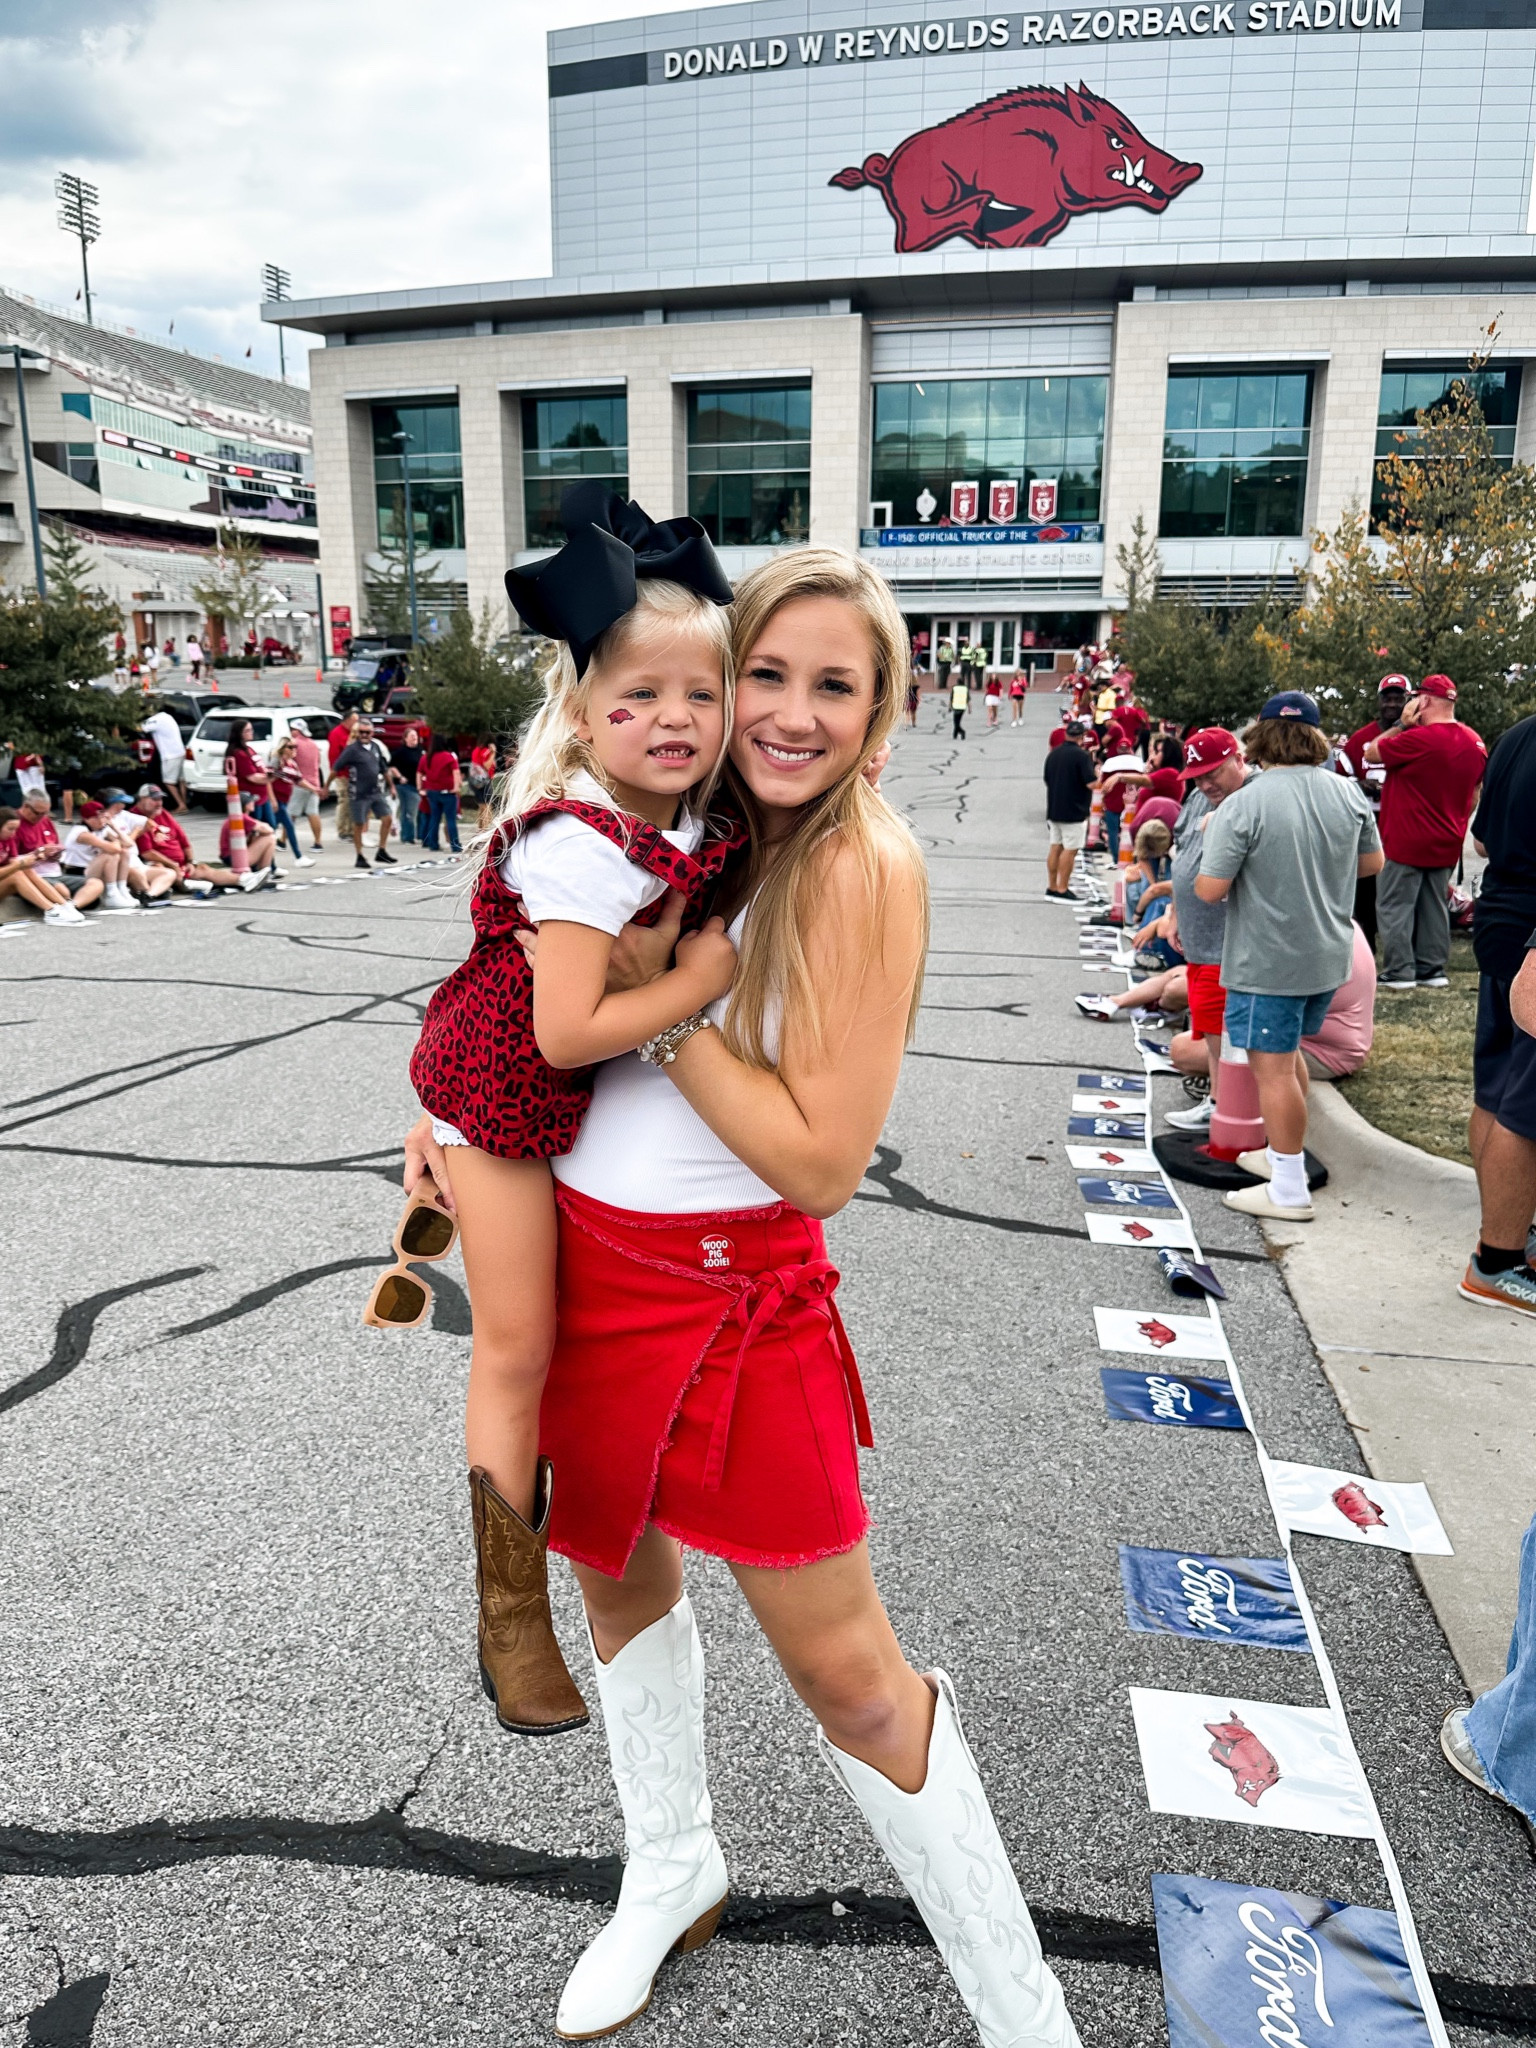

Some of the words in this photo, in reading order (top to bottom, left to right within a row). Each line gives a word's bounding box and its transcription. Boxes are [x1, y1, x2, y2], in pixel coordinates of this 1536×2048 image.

[664, 40, 788, 78] DONALD
[798, 35, 824, 63] W
[834, 18, 1010, 60] REYNOLDS
[1022, 4, 1235, 43] RAZORBACK
[1247, 0, 1402, 31] STADIUM
[918, 532, 959, 543] OFFICIAL
[961, 531, 993, 542] TRUCK
[994, 531, 1007, 541] OF
[1009, 530, 1028, 541] THE
[976, 554, 1037, 567] ATHLETIC
[1041, 553, 1092, 566] CENTER
[1187, 744, 1203, 764] A
[702, 1240, 728, 1250] WOOO
[709, 1250, 723, 1259] PIG
[704, 1257, 730, 1268] SOOIE!
[1145, 1376, 1194, 1421] Ford
[1177, 1558, 1240, 1634] Ford
